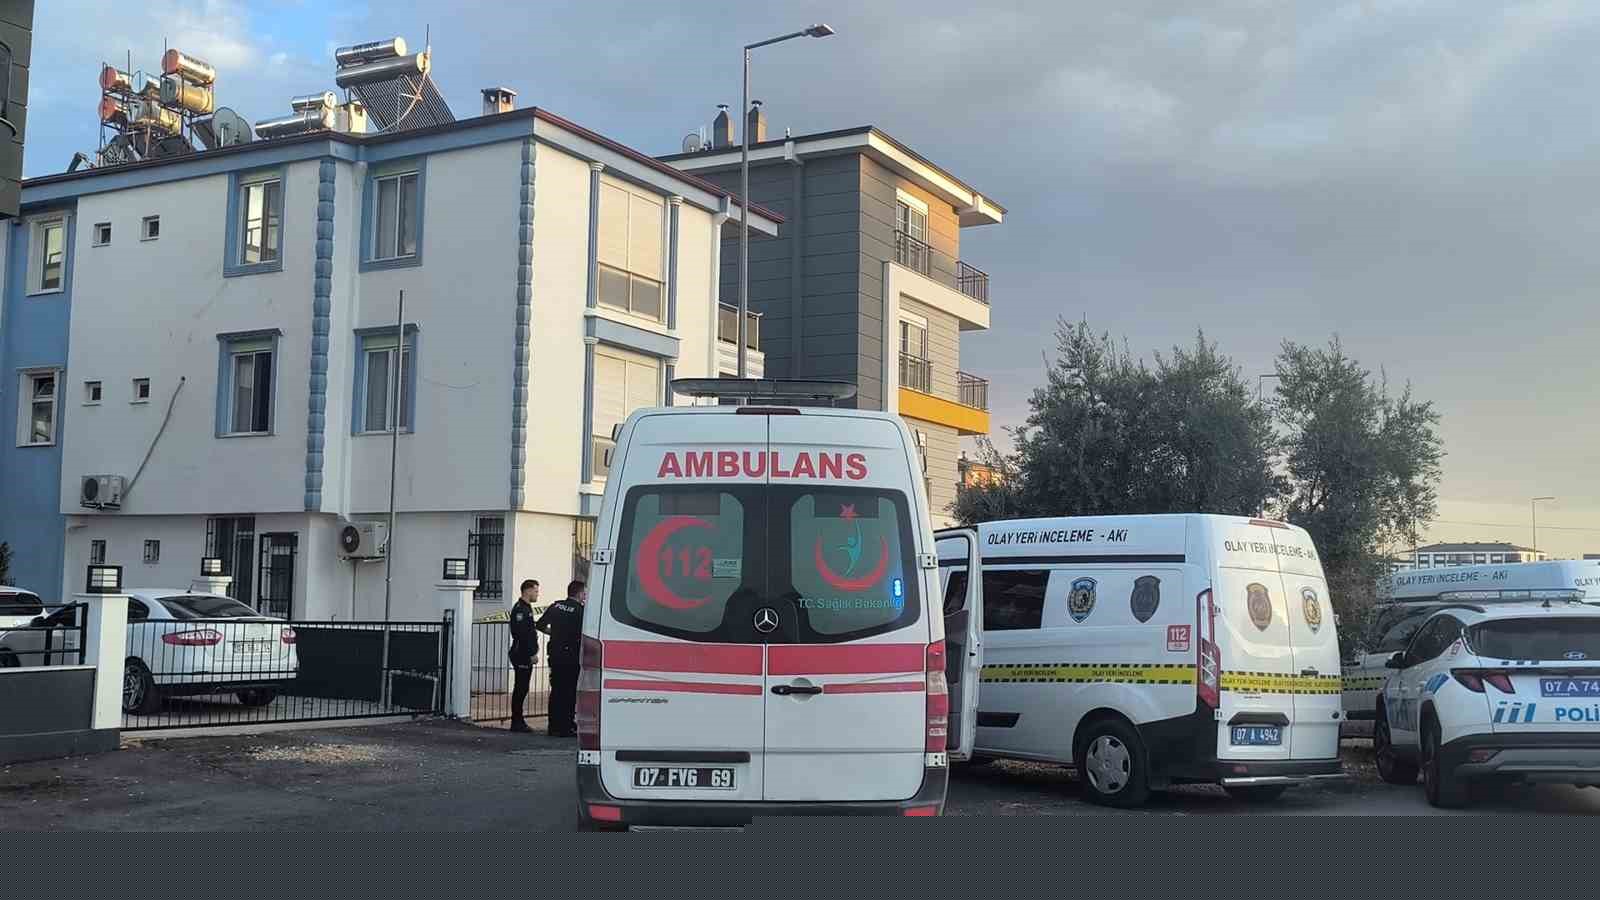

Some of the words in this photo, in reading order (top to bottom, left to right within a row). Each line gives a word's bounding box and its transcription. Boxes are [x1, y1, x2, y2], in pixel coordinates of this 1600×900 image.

[657, 451, 868, 480] AMBULANS
[988, 531, 1014, 545] OLAY
[1224, 540, 1247, 552] OLAY
[659, 546, 713, 579] 112
[1170, 628, 1187, 641] 112
[1544, 681, 1562, 693] 07
[1567, 681, 1579, 692] A
[1581, 681, 1600, 694] 74
[1236, 728, 1247, 740] 07
[1250, 728, 1256, 740] A
[640, 768, 660, 786] 07
[711, 769, 731, 787] 69
